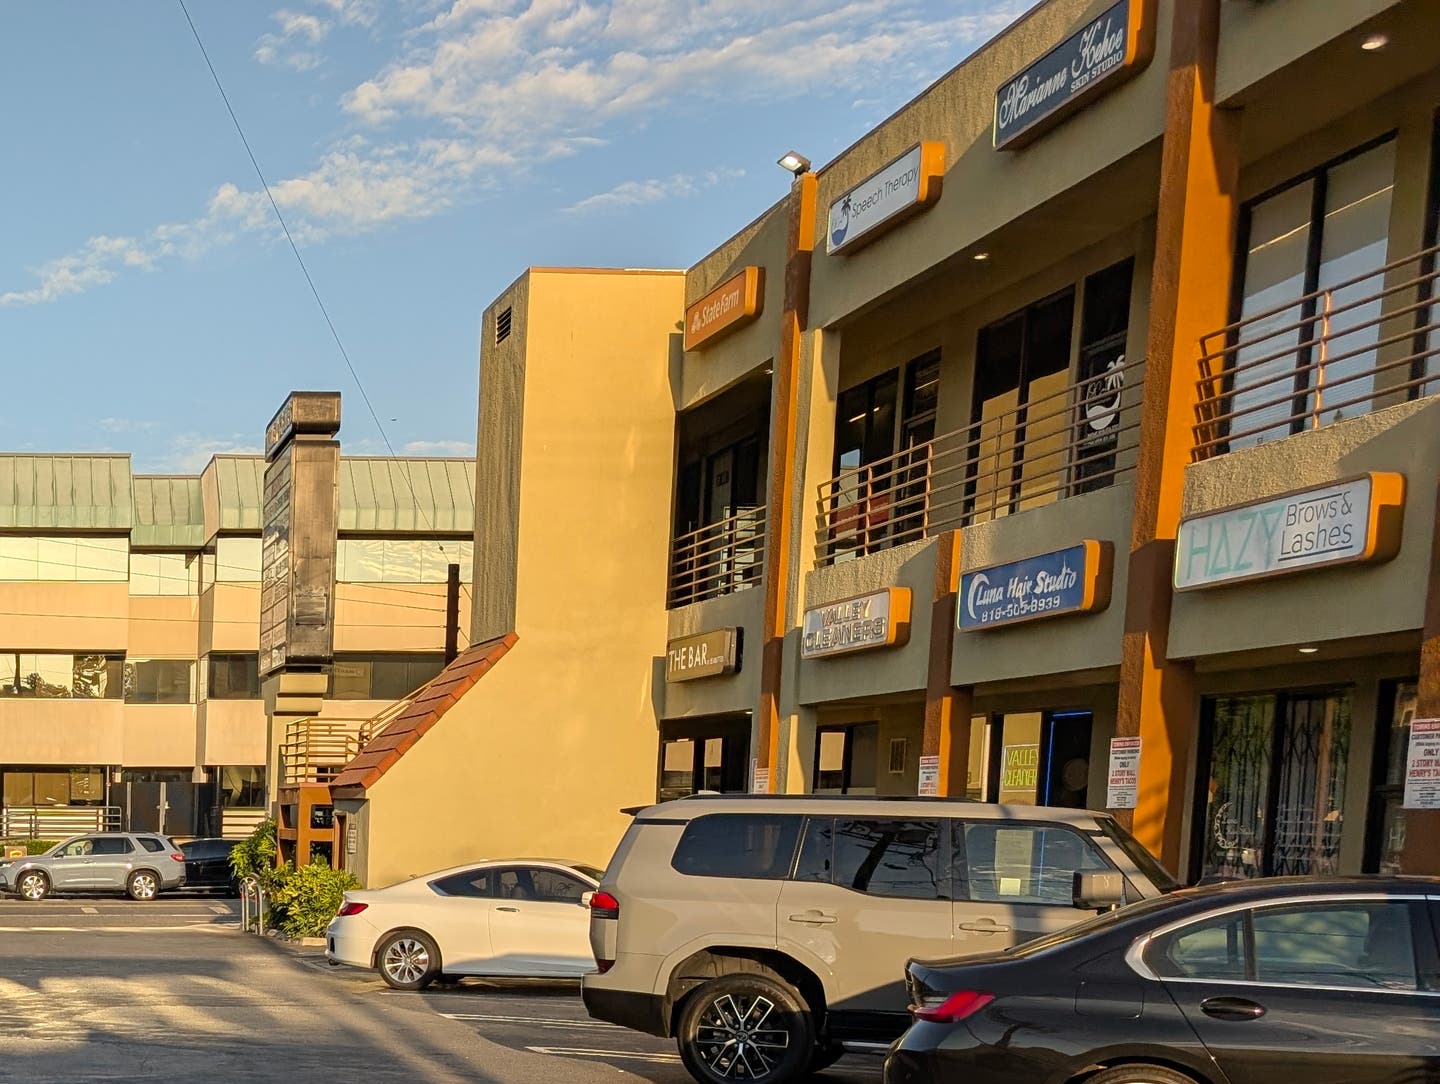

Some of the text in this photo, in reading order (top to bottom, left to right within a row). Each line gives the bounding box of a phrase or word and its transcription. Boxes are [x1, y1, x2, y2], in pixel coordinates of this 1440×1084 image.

[998, 17, 1124, 130] Marianne Kehoe
[1070, 50, 1123, 94] SKIN STUDIO
[851, 164, 920, 219] Speech Therapy
[1285, 490, 1353, 528] Brows &
[1186, 503, 1285, 580] HAZY
[1280, 522, 1353, 556] Lashes
[975, 562, 1077, 606] Luna Hair Studio
[820, 599, 873, 628] VALLEY
[805, 616, 887, 652] CLEANERS
[668, 642, 708, 673] THE BAR
[1423, 748, 1440, 757] ONLY
